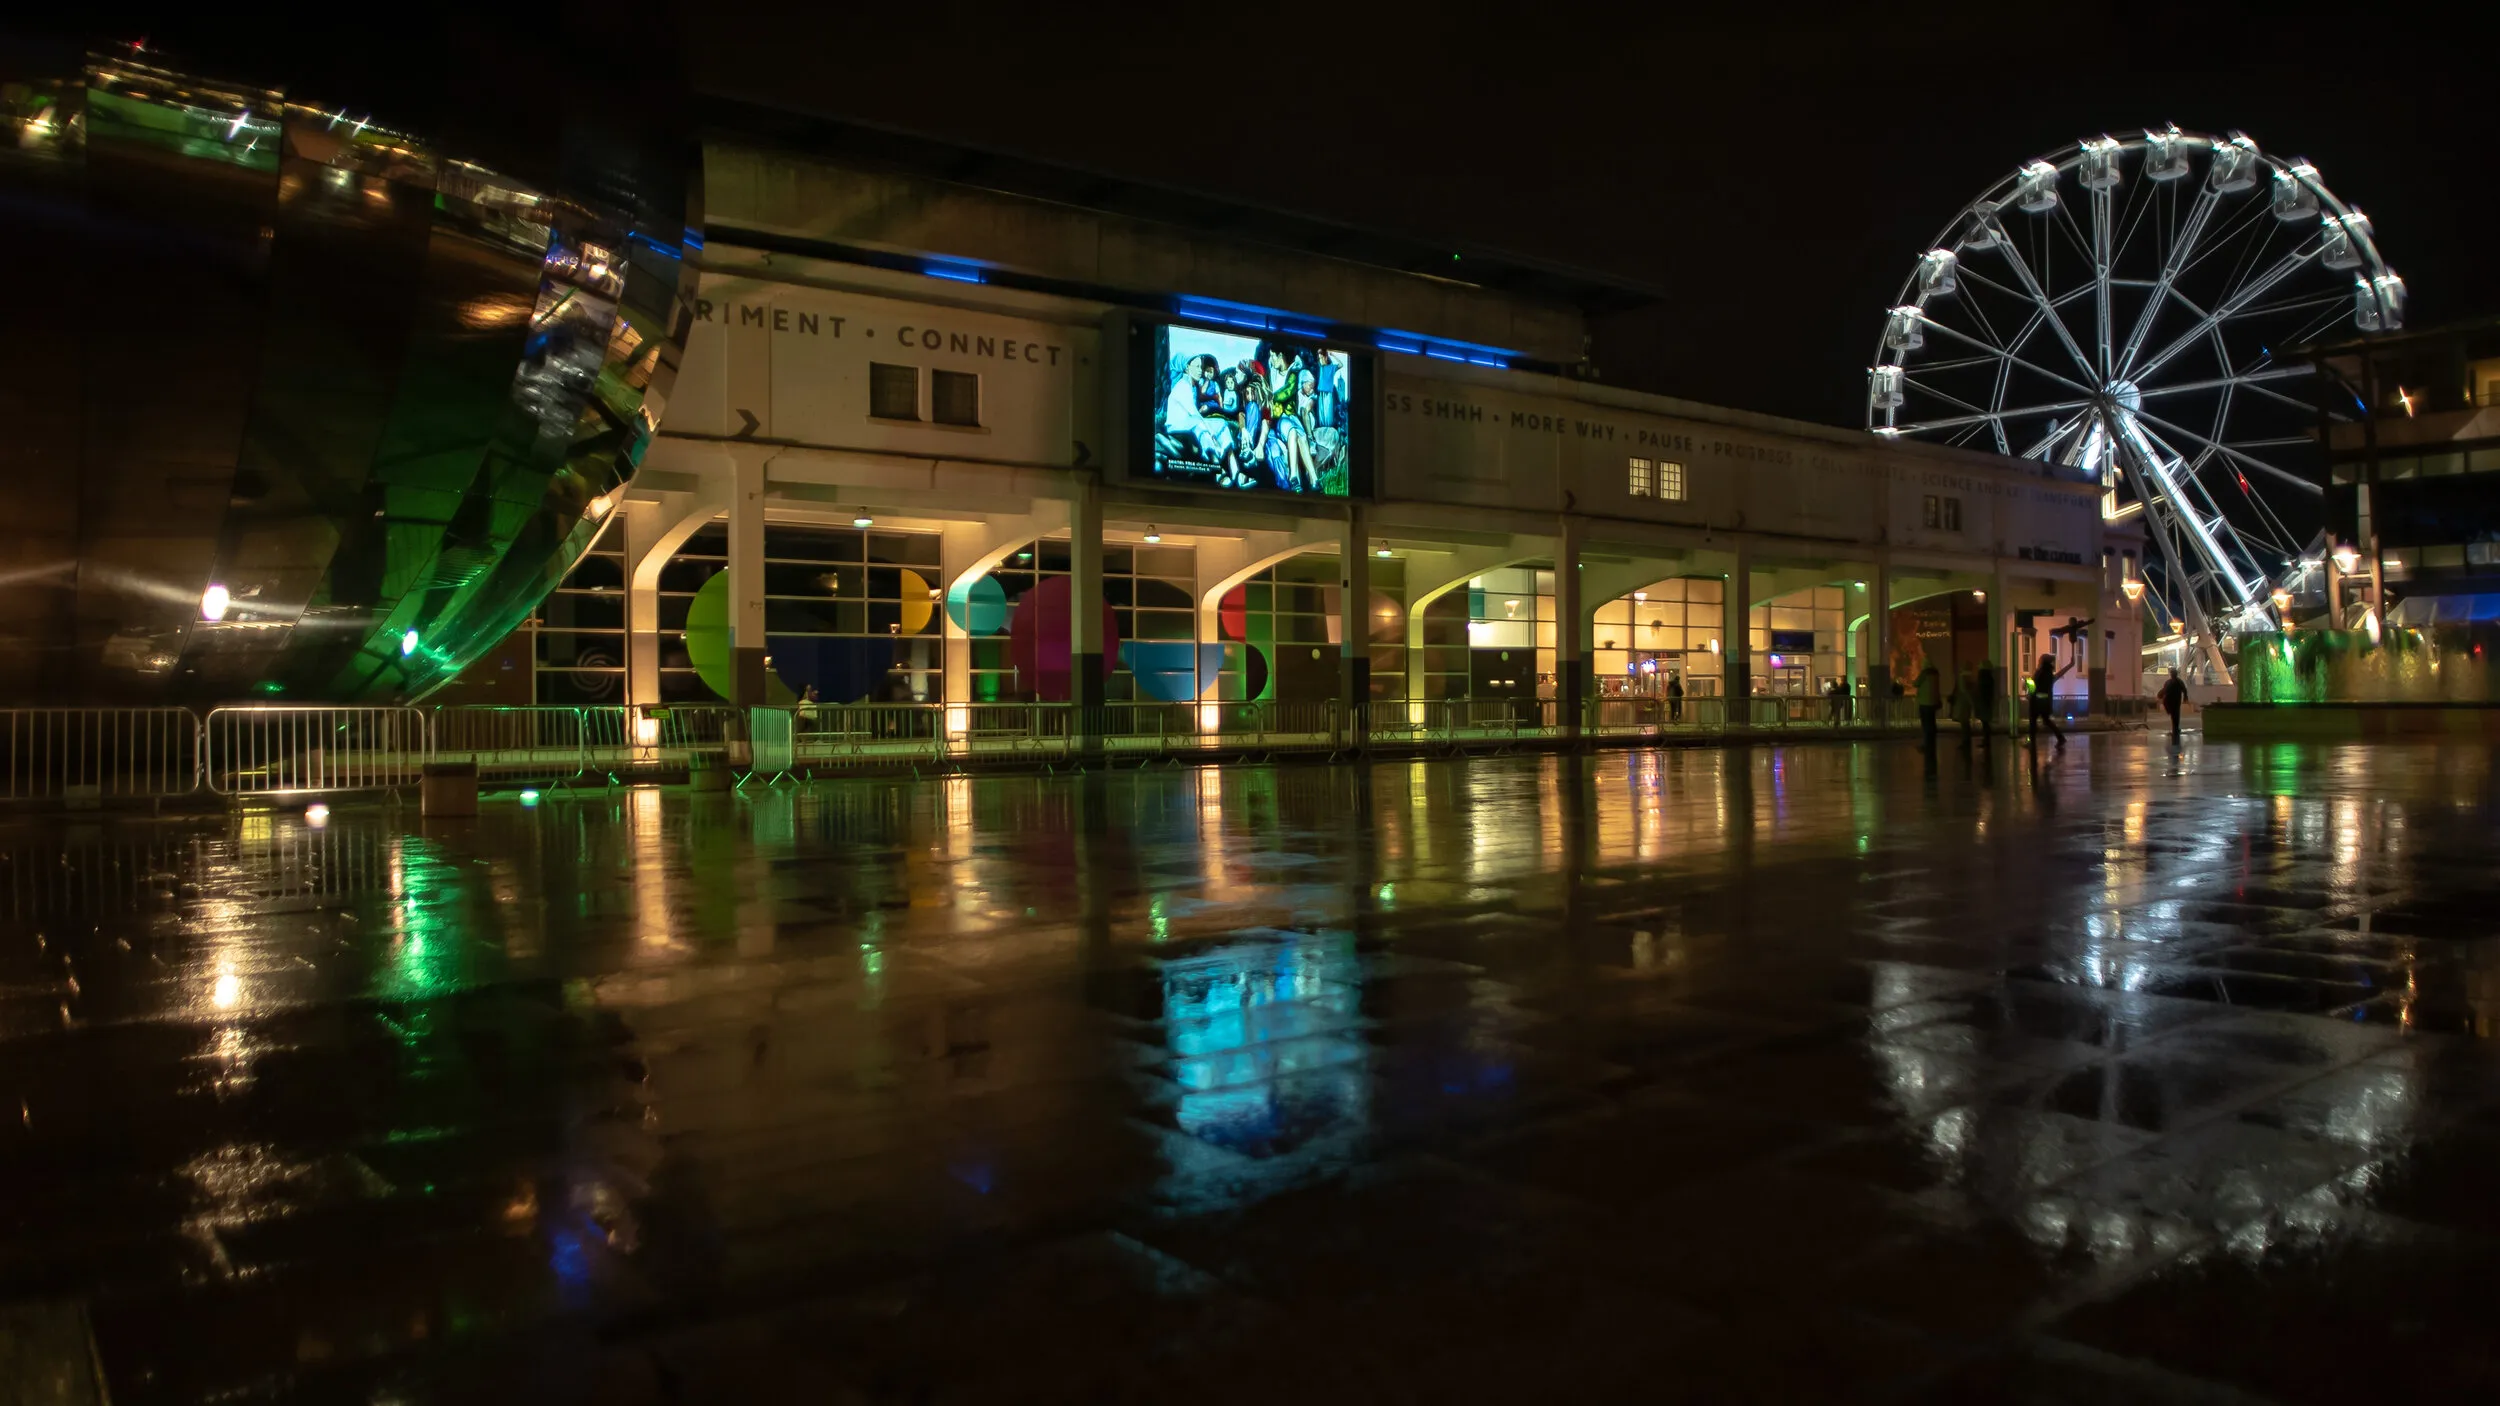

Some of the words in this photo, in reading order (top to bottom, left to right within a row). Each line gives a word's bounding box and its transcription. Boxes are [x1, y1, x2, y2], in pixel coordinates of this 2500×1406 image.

[898, 326, 1061, 366] CONNECT
[1422, 399, 1482, 422] SHHH
[1511, 411, 1566, 433] MORE
[1575, 421, 1614, 441] WHY
[1638, 430, 1693, 452] PAUSE
[1922, 472, 1971, 491] SCIENCE
